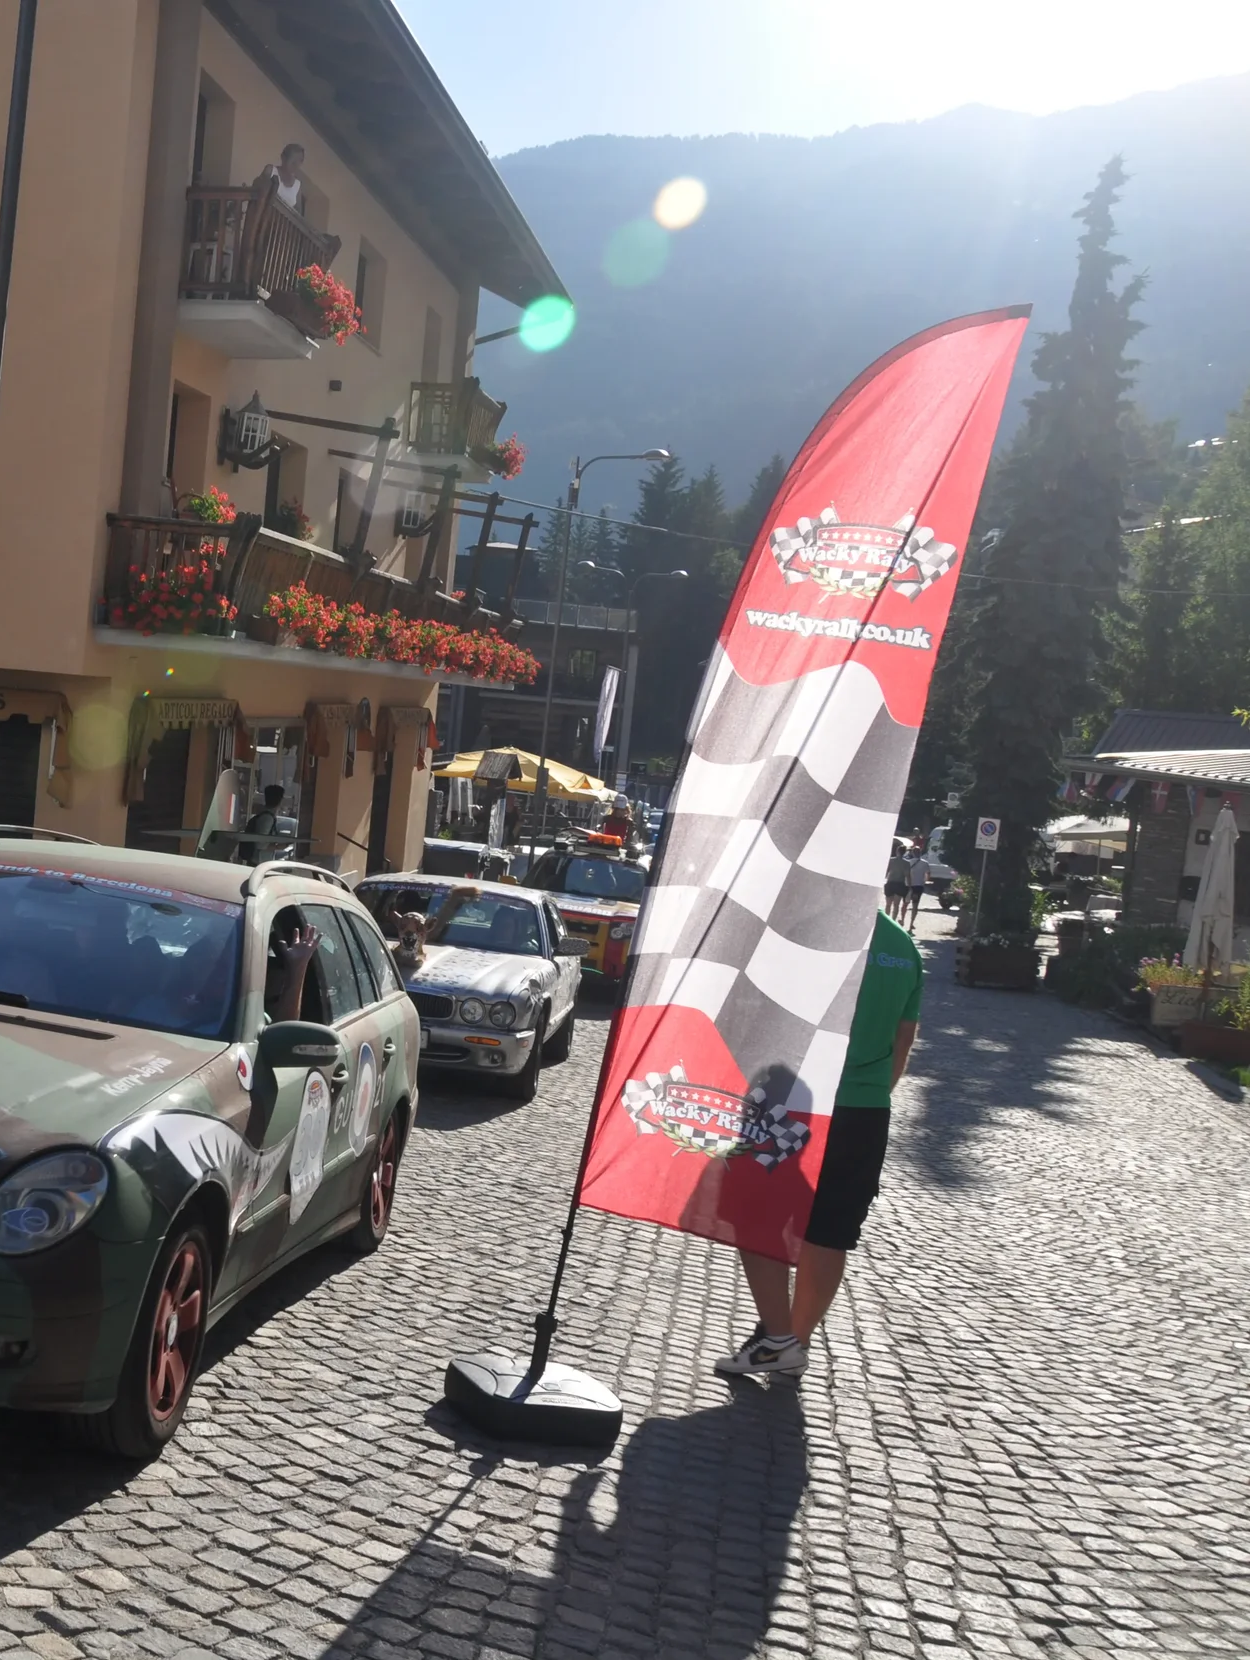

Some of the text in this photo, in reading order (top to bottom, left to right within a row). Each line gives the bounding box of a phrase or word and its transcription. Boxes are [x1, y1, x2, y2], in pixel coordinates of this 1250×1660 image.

[799, 546, 863, 565] Wacky
[746, 609, 932, 650] wackyrallyco.uk
[159, 702, 233, 719] ARTICOLI REGALO
[70, 872, 173, 898] Barcelona
[650, 1099, 771, 1144] Wacky Rally
